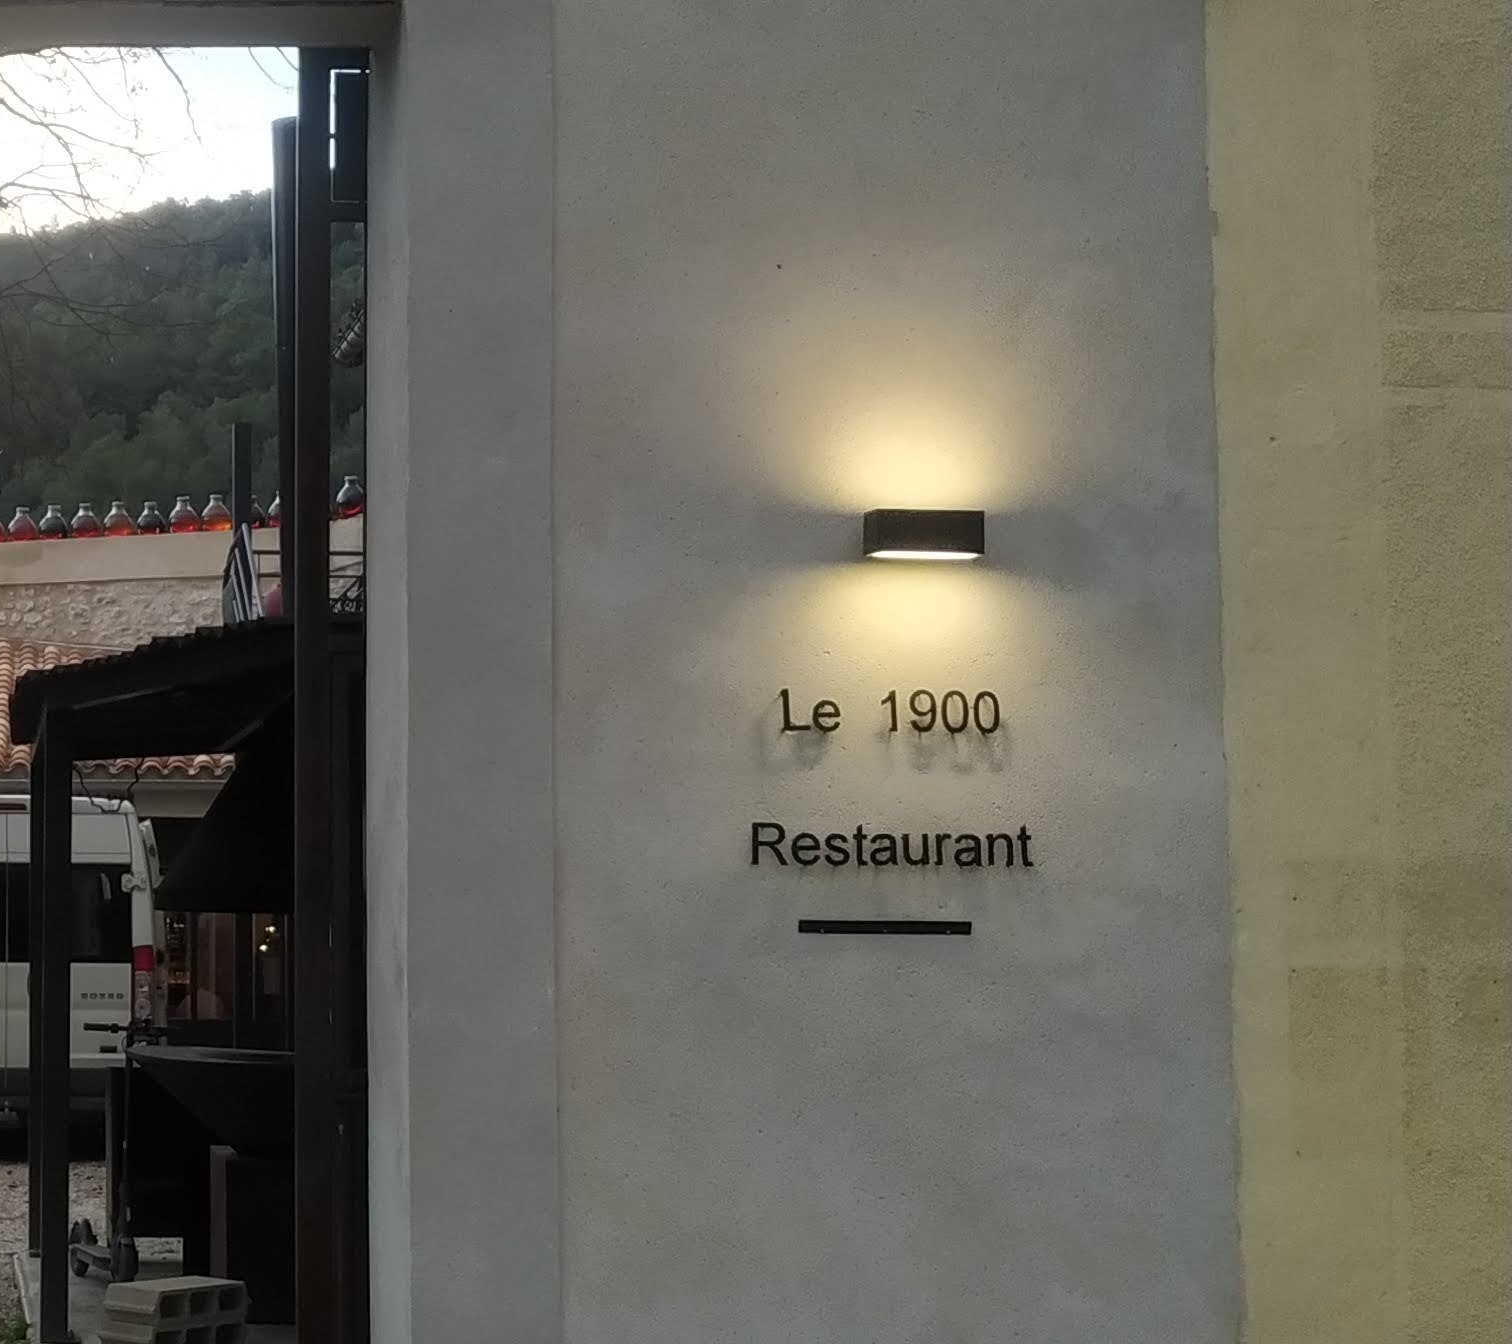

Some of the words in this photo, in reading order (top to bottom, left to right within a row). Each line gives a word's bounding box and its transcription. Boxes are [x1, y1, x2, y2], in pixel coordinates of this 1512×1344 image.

[778, 688, 842, 734] Le
[880, 689, 1001, 735] 1900
[750, 822, 1034, 869] Restaurant
